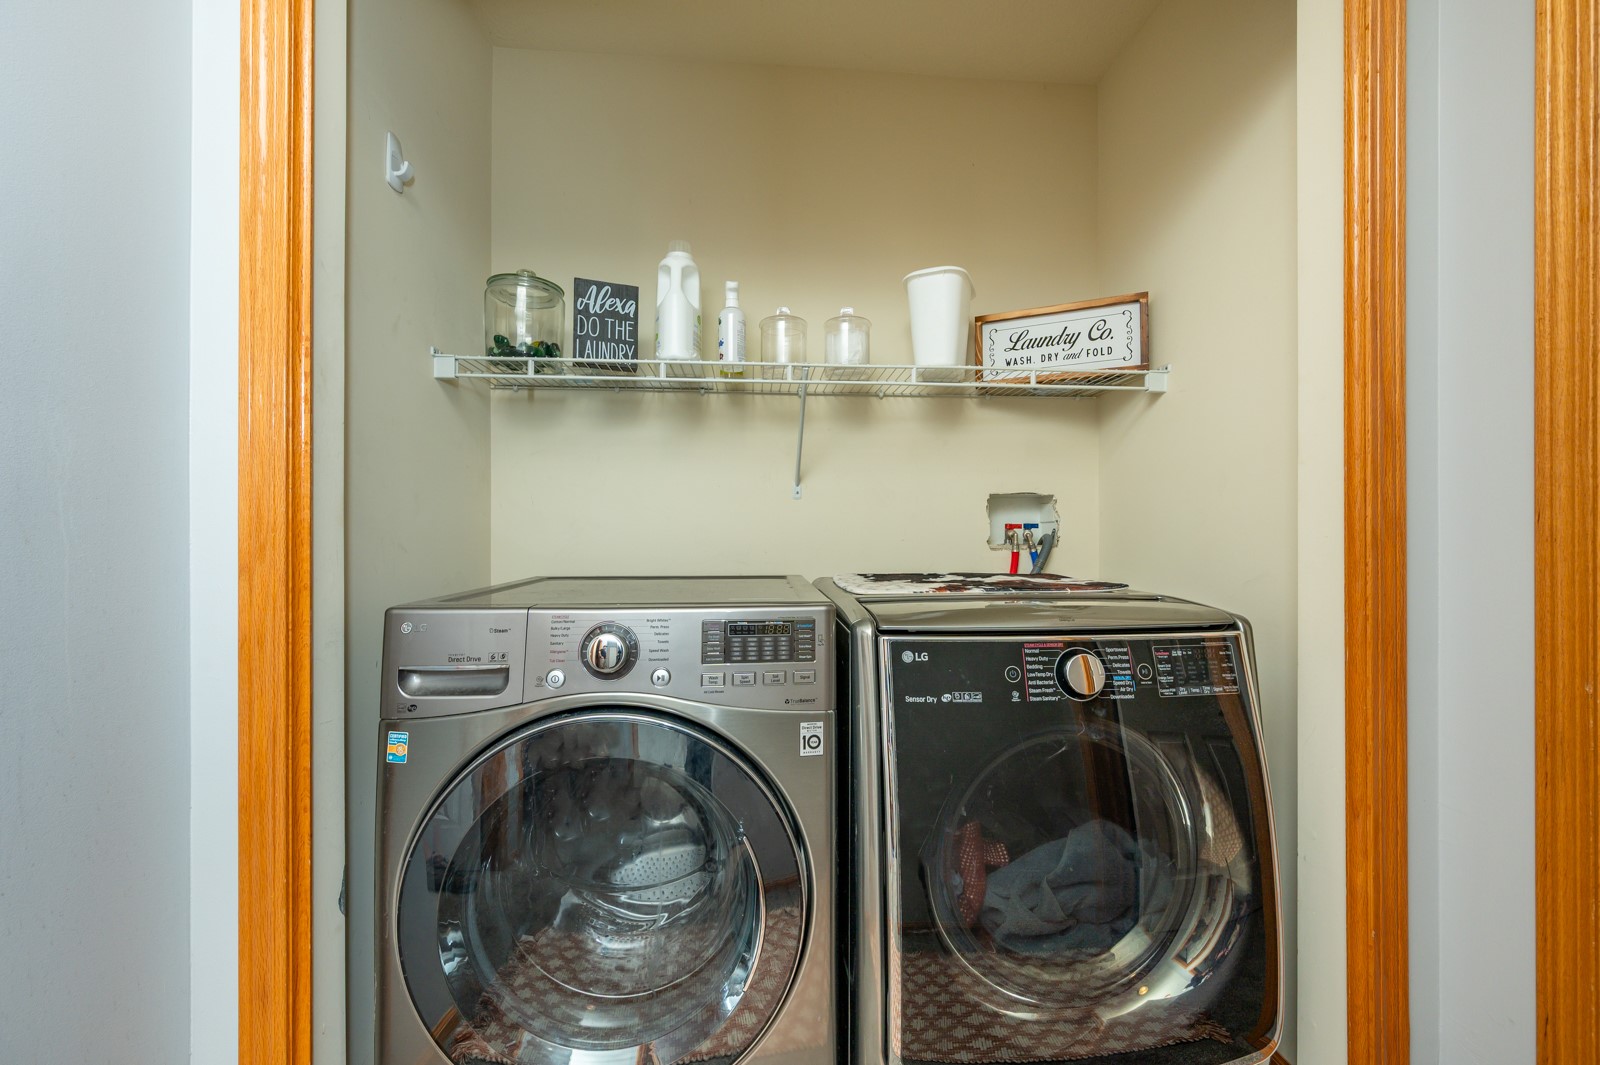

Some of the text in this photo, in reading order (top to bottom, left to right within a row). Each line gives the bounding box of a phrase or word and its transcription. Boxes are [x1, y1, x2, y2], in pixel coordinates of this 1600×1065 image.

[577, 284, 636, 318] Alexa
[577, 314, 635, 341] DO THE
[1004, 319, 1114, 352] Laundry Co.
[576, 338, 635, 364] LAUNDRY
[1041, 352, 1059, 363] DRY
[1062, 348, 1084, 361] and
[1086, 346, 1113, 358] FOLD
[915, 652, 929, 661] LG
[926, 695, 938, 704] Dry
